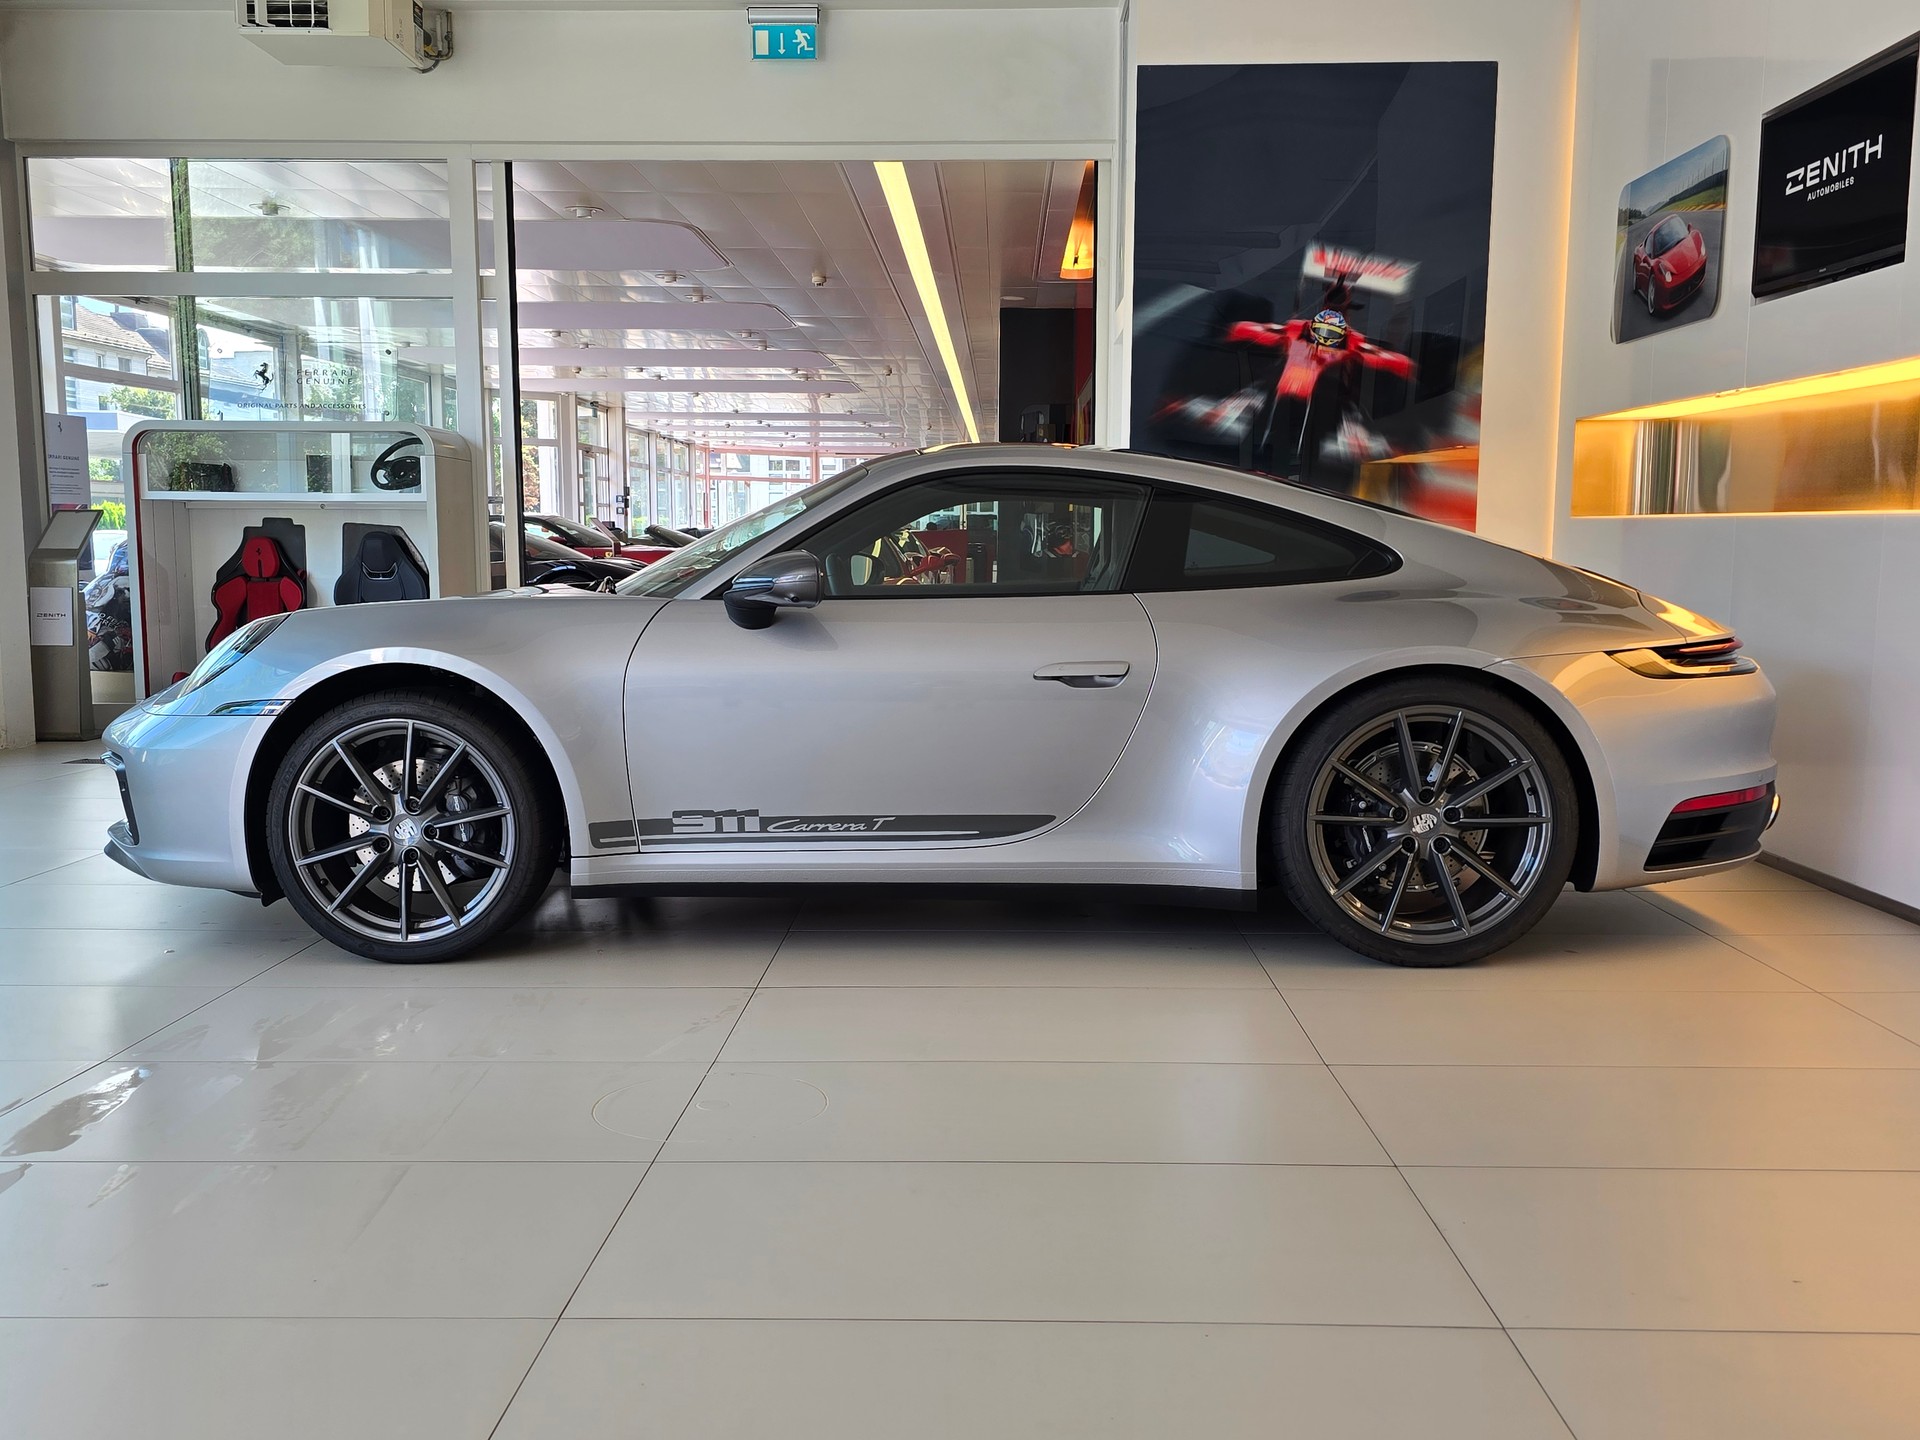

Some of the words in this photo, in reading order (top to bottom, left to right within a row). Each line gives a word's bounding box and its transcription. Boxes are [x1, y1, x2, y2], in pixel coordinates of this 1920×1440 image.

[1785, 134, 1883, 196] ZENITH
[1806, 176, 1855, 202] AUTOMOBILES
[296, 377, 353, 385] GENUINE
[318, 402, 367, 410] ACCESSORIES
[672, 808, 761, 833] 911
[766, 818, 868, 832] Carrera
[872, 816, 896, 831] T
